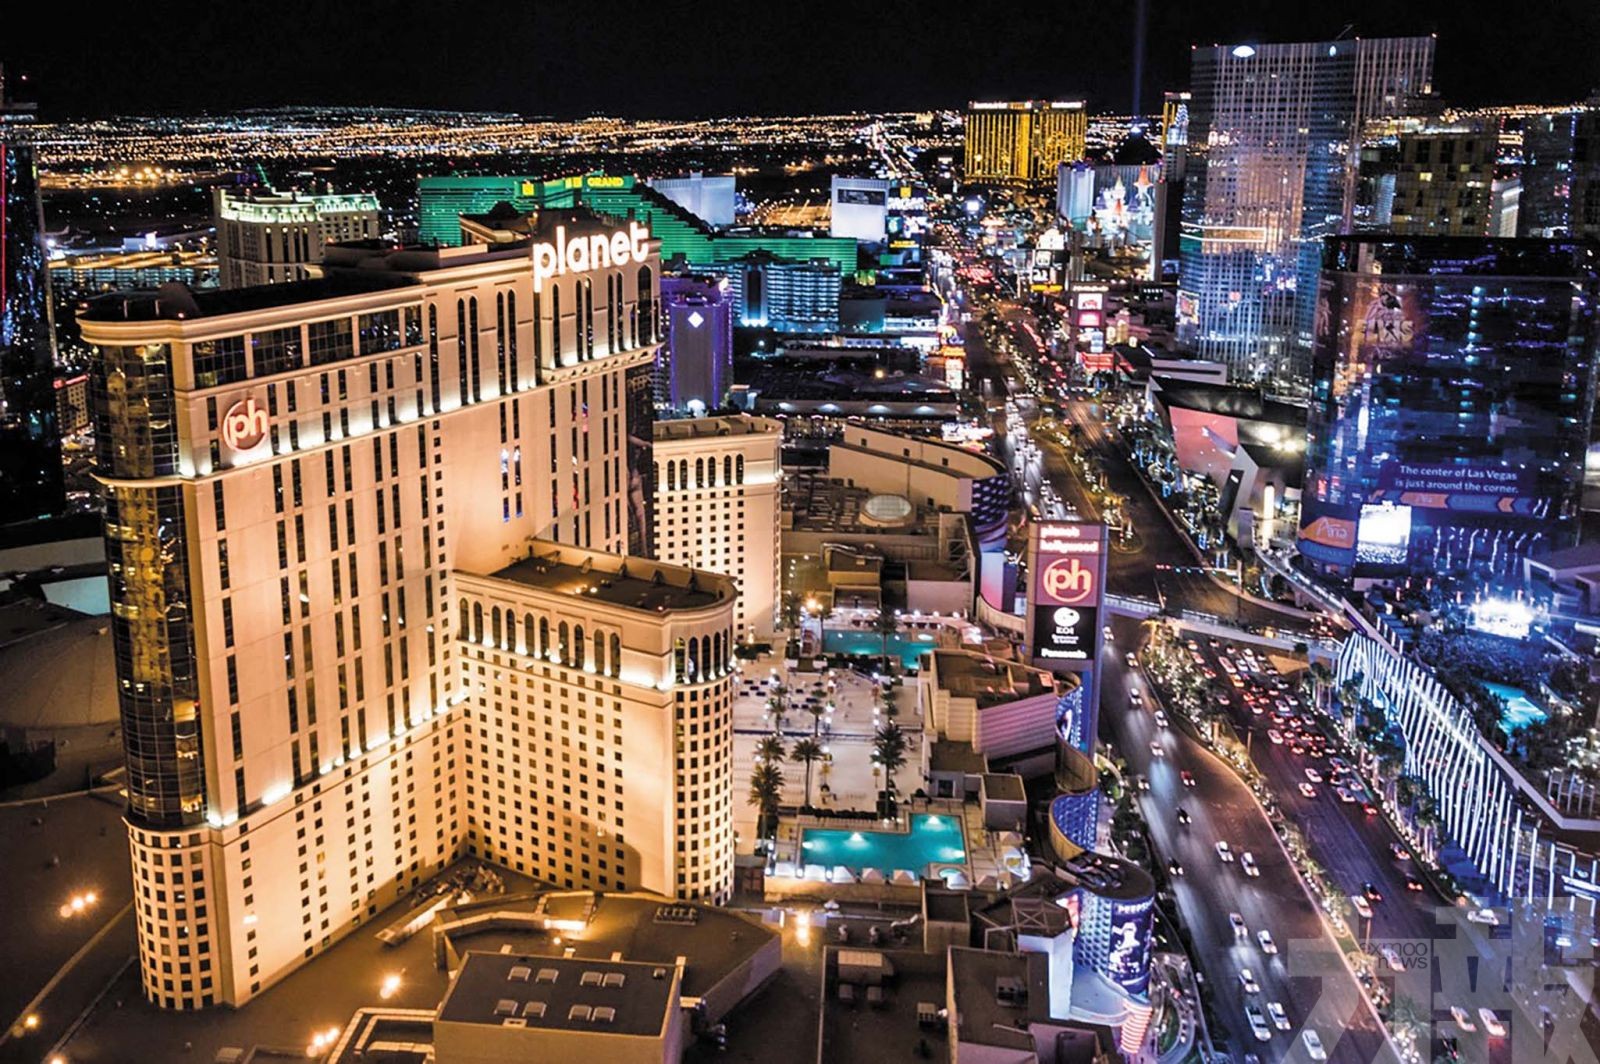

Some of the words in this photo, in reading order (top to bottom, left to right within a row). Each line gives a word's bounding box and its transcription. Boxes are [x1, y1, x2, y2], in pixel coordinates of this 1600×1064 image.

[532, 221, 649, 294] planet
[228, 399, 269, 449] ph
[1395, 478, 1403, 487] is
[1405, 479, 1425, 489] just
[1426, 481, 1463, 491] around
[1464, 481, 1482, 492] the
[1483, 485, 1520, 494] corner.
[1400, 465, 1419, 475] The
[1421, 467, 1453, 477] center
[1454, 468, 1466, 477] of
[1467, 469, 1485, 479] Las
[1486, 470, 1518, 481] Vegas
[1048, 559, 1093, 597] ph
